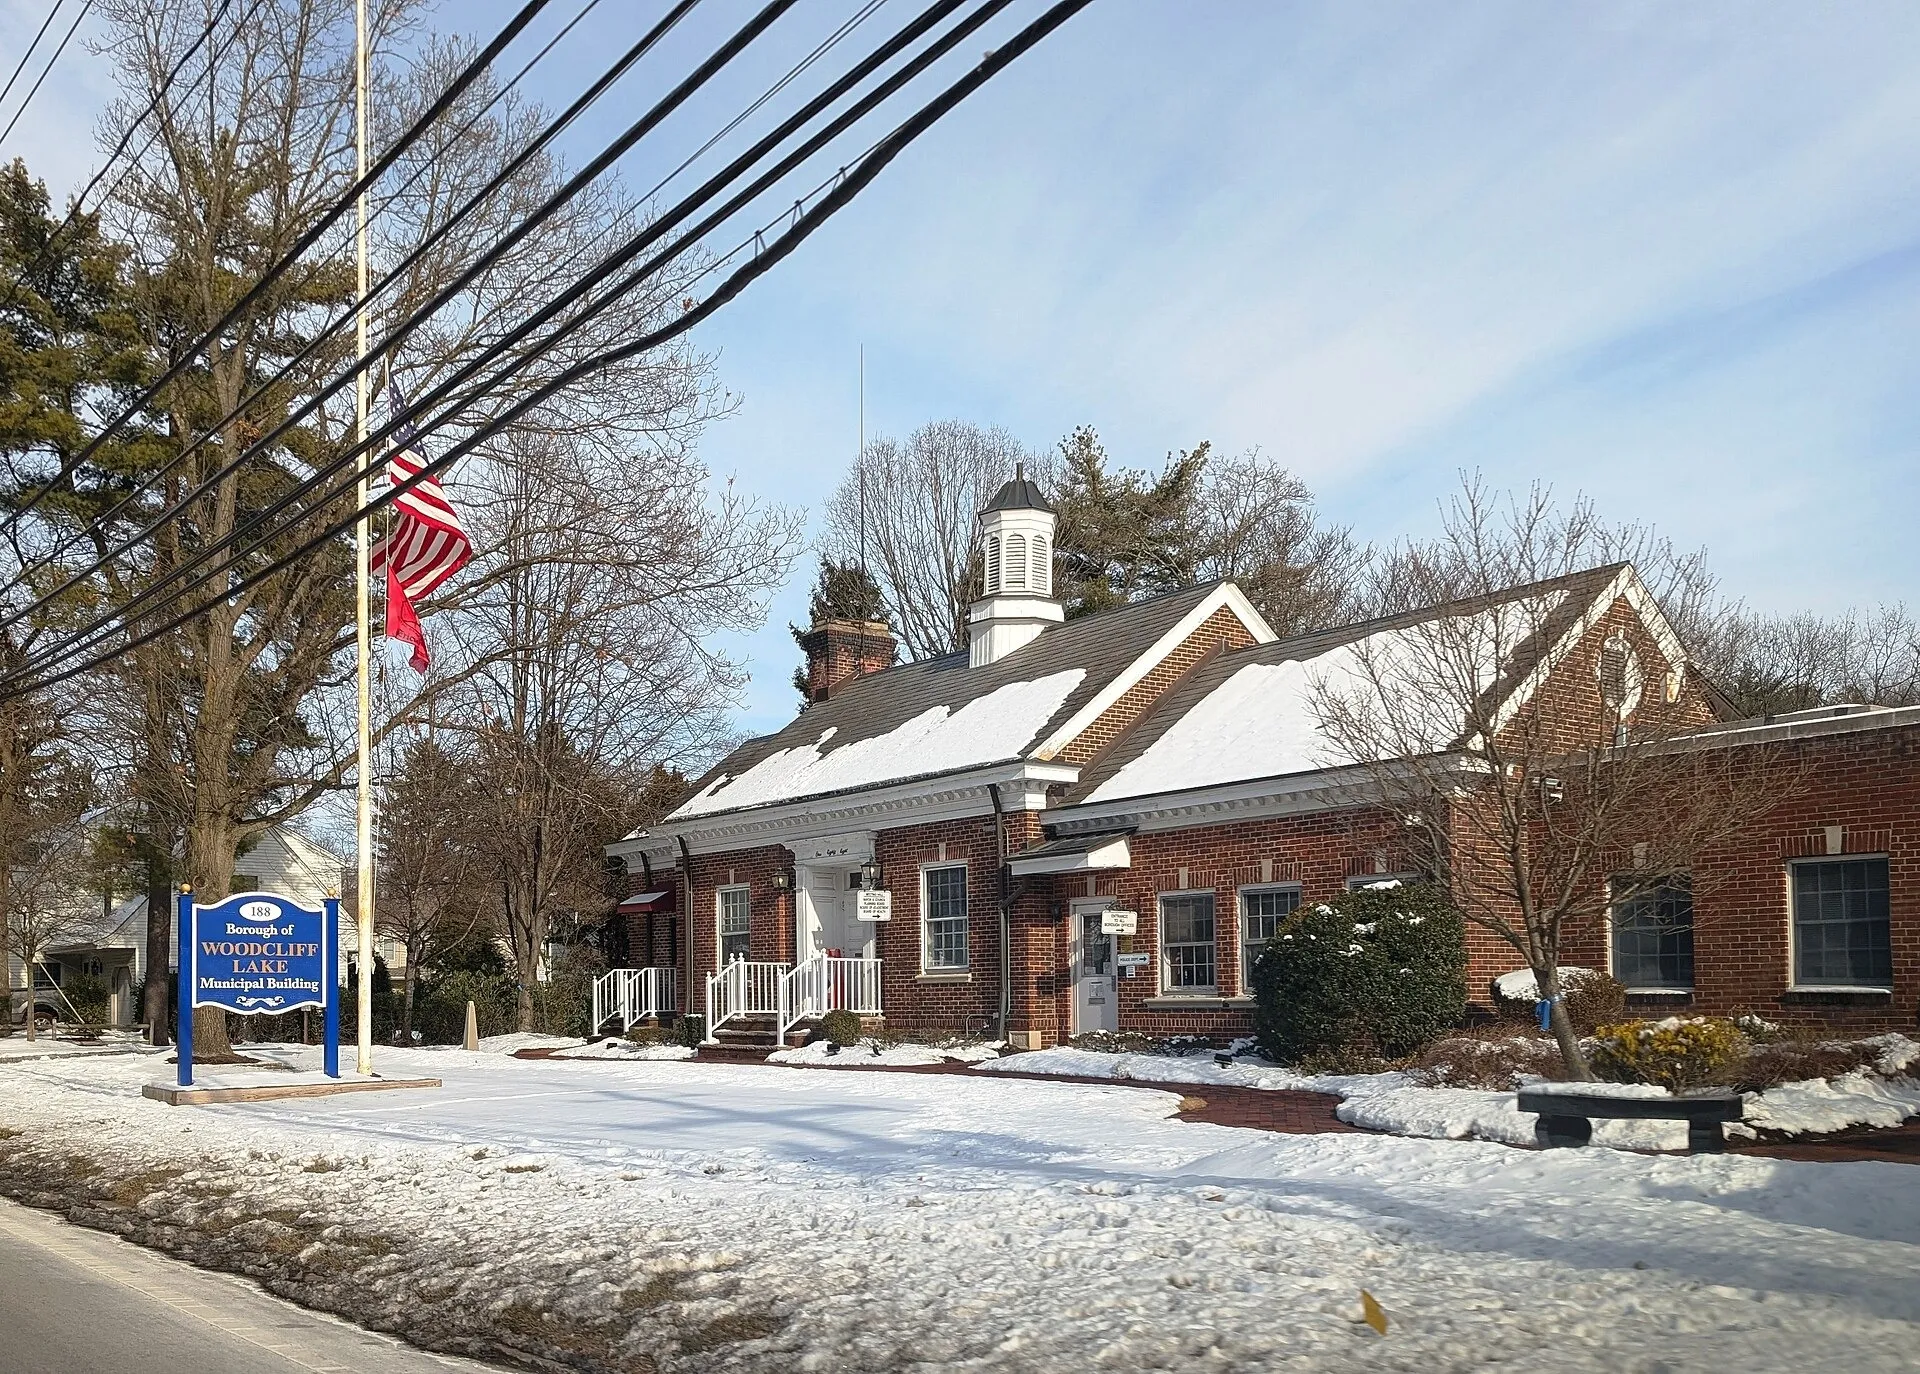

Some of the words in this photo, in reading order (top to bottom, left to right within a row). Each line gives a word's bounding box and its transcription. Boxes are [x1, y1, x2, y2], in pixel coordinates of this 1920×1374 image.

[251, 906, 271, 917] 188
[225, 922, 278, 939] Borough
[280, 924, 295, 936] of
[201, 941, 319, 957] WOODCLIFF
[232, 959, 289, 973] LAKE
[200, 977, 265, 992] Municipal
[266, 977, 319, 993] Building
